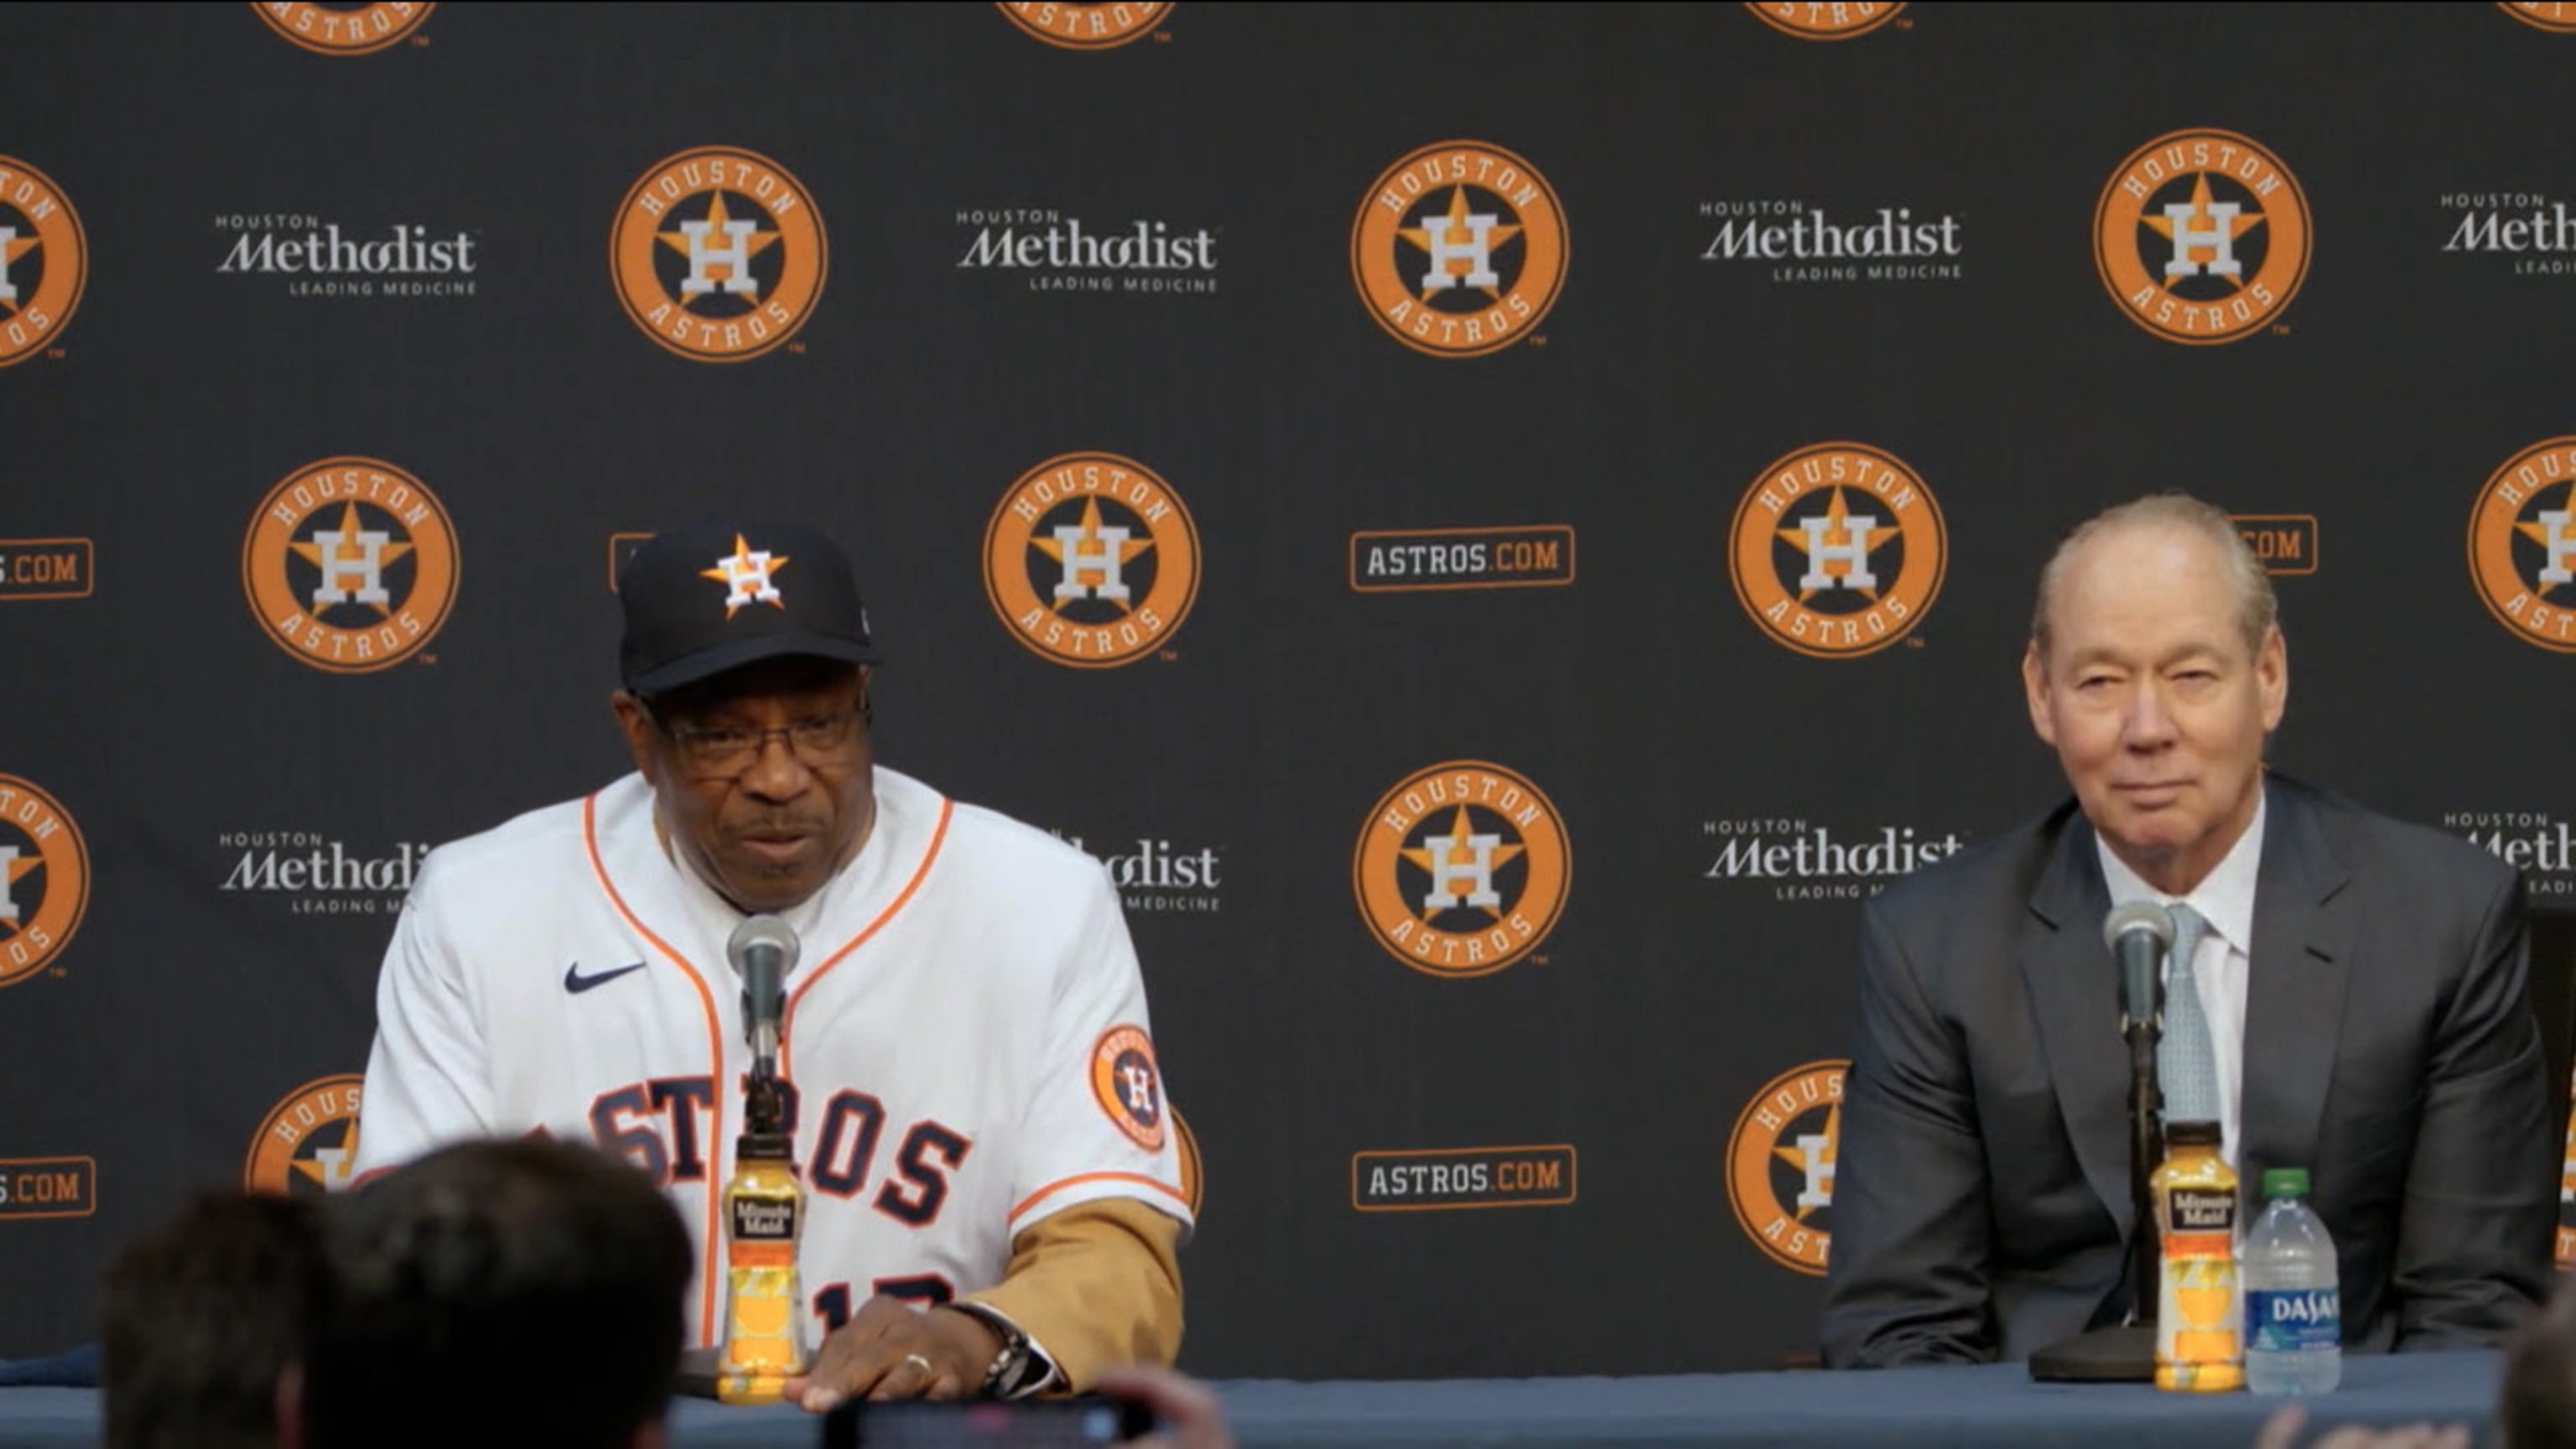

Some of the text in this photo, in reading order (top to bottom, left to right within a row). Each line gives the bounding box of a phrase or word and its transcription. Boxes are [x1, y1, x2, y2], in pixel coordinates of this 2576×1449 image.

[1381, 155, 1539, 212] HOUSTON
[2123, 143, 2281, 199] HOUSTON
[640, 161, 796, 216] HOUSTON
[2441, 193, 2544, 208] HOUSTON
[216, 215, 319, 228] HOUSTON
[956, 210, 1058, 224] HOUSTON
[1700, 200, 1802, 215] HOUSTON
[216, 225, 476, 273] Methodist
[956, 219, 1217, 270] Methodist
[1701, 209, 1961, 259] Methodist
[1774, 265, 1961, 281] LEADING MEDICINE
[2515, 260, 2576, 274] LEADI
[289, 282, 475, 294] LEADING MEDICINE
[1031, 277, 1216, 292] LEADING MEDICINE
[1389, 294, 1530, 342] ASTROS
[2132, 283, 2273, 330] ASTROS
[649, 302, 789, 348] ASTROS
[273, 472, 429, 526] HOUSTON
[1013, 467, 1171, 522] HOUSTON
[1760, 457, 1916, 513] HOUSTON
[1368, 541, 1559, 576] ASTROS.COM
[282, 612, 420, 658] ASTROS
[1021, 609, 1161, 653] ASTROS
[1767, 597, 1907, 643] ASTROS
[1384, 775, 1540, 833] HOUSTON
[2444, 813, 2547, 828] HOUSTON
[220, 833, 322, 846] HOUSTON
[1704, 819, 1806, 834] HOUSTON
[293, 900, 375, 913] LEADING
[1126, 896, 1220, 911] MEDICINE
[1777, 885, 1859, 900] LEADING
[1391, 914, 1532, 962] ASTROS
[522, 1074, 974, 1229] STOS
[1369, 1161, 1561, 1195] ASTROS.COM
[737, 1201, 792, 1219] Minute
[2174, 1191, 2233, 1211] Minute
[2183, 1208, 2226, 1225] Maid
[745, 1218, 786, 1234] Maid
